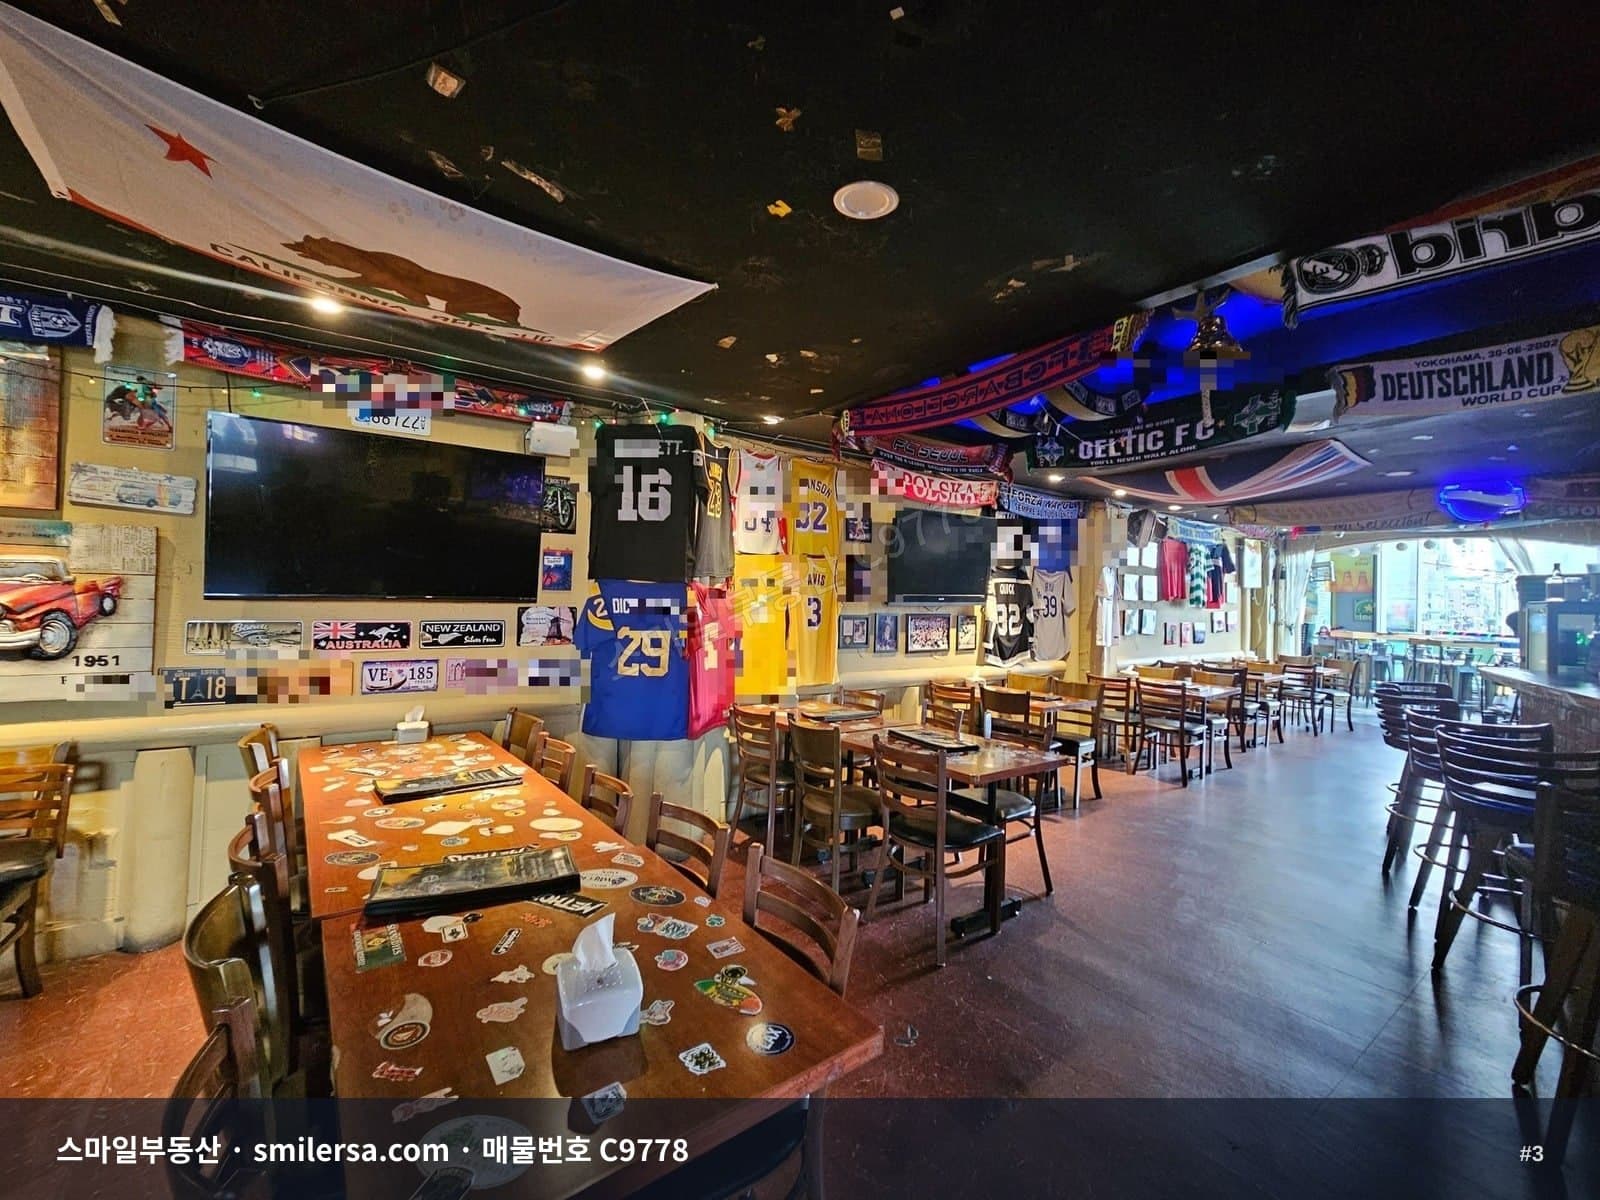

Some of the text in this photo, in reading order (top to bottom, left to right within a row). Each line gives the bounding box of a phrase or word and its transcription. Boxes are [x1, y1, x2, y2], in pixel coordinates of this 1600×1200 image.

[209, 242, 409, 312] CALIFORNIA
[1414, 352, 1486, 369] YOKOHAMA,
[1380, 351, 1554, 402] DEUTSCHLAND
[1461, 384, 1565, 407] WORLD CUP
[917, 444, 970, 463] SEOUL
[1079, 430, 1164, 460] CELTIC
[1117, 455, 1141, 463] NEVER
[1144, 451, 1167, 459] WALK
[1169, 445, 1197, 455] ALONE
[615, 465, 672, 521] 16
[903, 471, 977, 505] POLSKA
[1010, 486, 1042, 507] FORZA
[593, 598, 608, 618] 2
[425, 623, 500, 632] NEW ZEALAND
[325, 639, 402, 650] AUSTRALIA
[464, 635, 497, 644] Silver Fern
[72, 655, 121, 667] 1951
[617, 626, 671, 677] 29
[409, 666, 434, 680] 185
